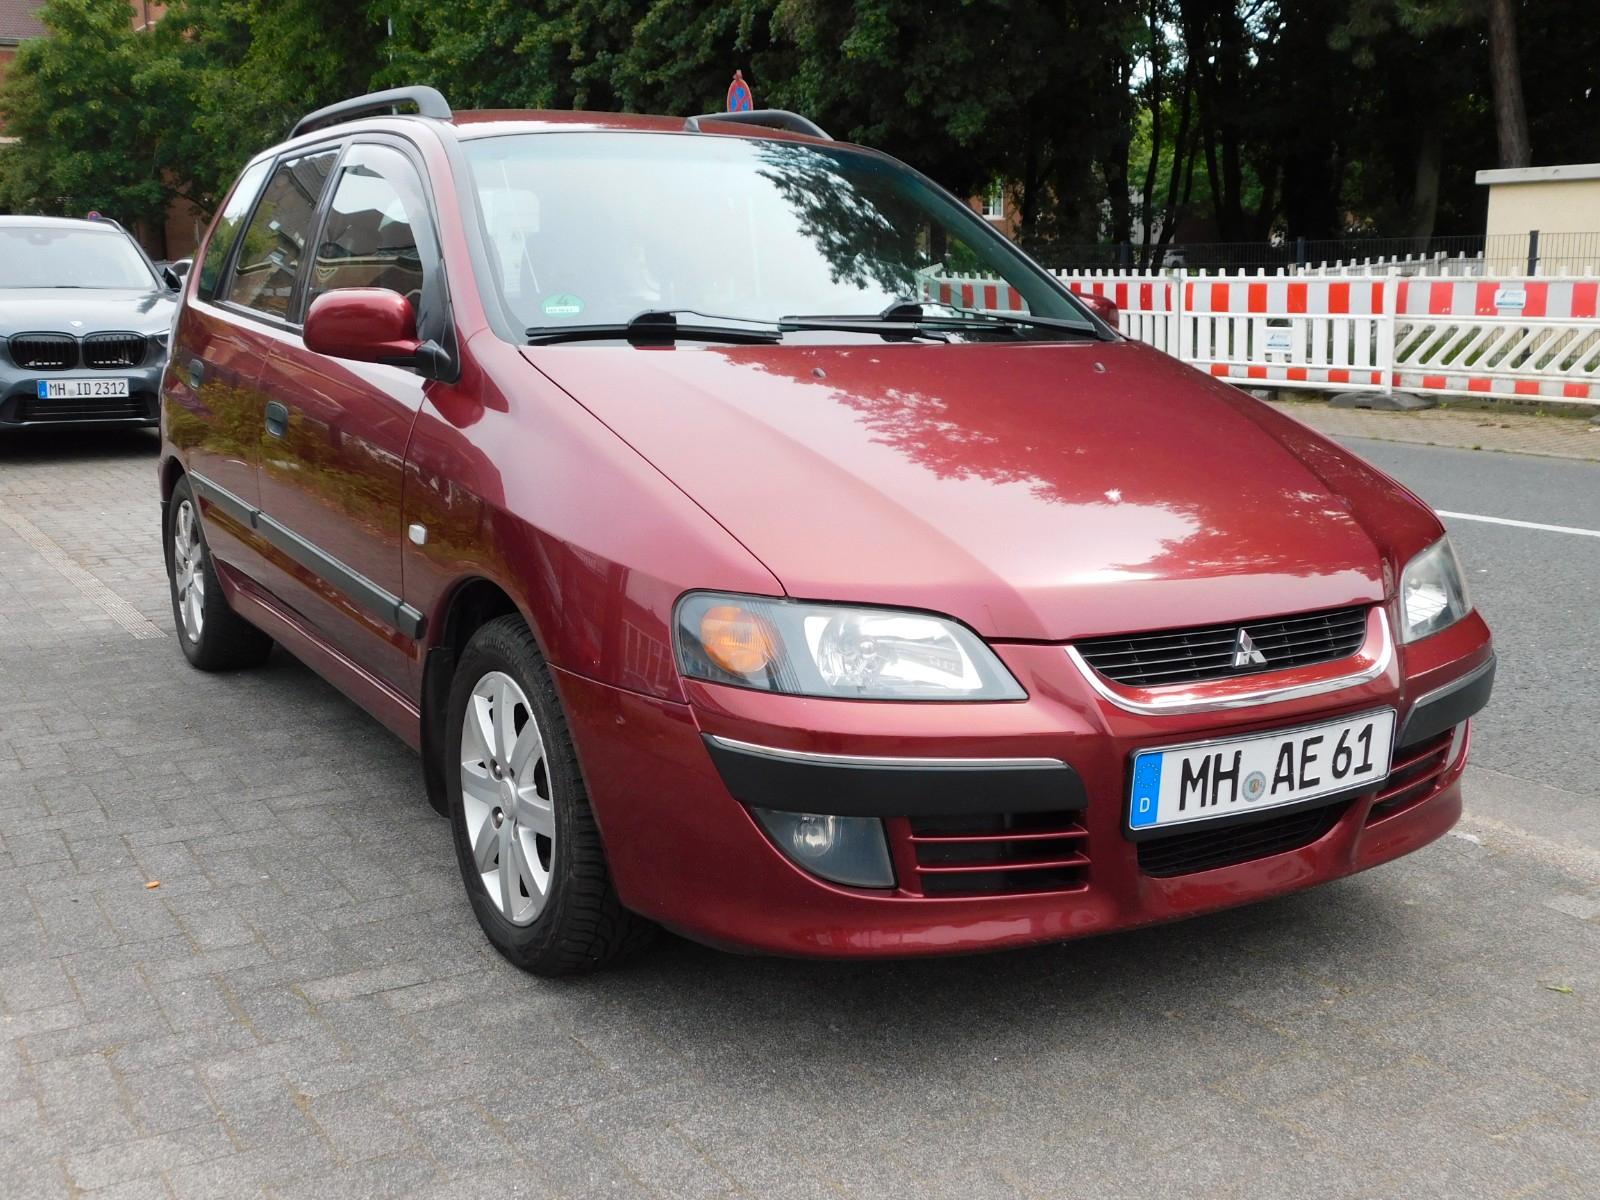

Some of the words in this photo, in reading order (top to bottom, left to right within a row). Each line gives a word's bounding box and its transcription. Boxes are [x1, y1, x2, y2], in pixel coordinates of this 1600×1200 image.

[49, 383, 66, 396] MH
[76, 382, 91, 396] ID
[94, 382, 126, 395] 2312
[1178, 750, 1242, 811] MH
[1270, 735, 1324, 795] AE
[1331, 723, 1374, 780] 61
[1139, 797, 1150, 813] D
